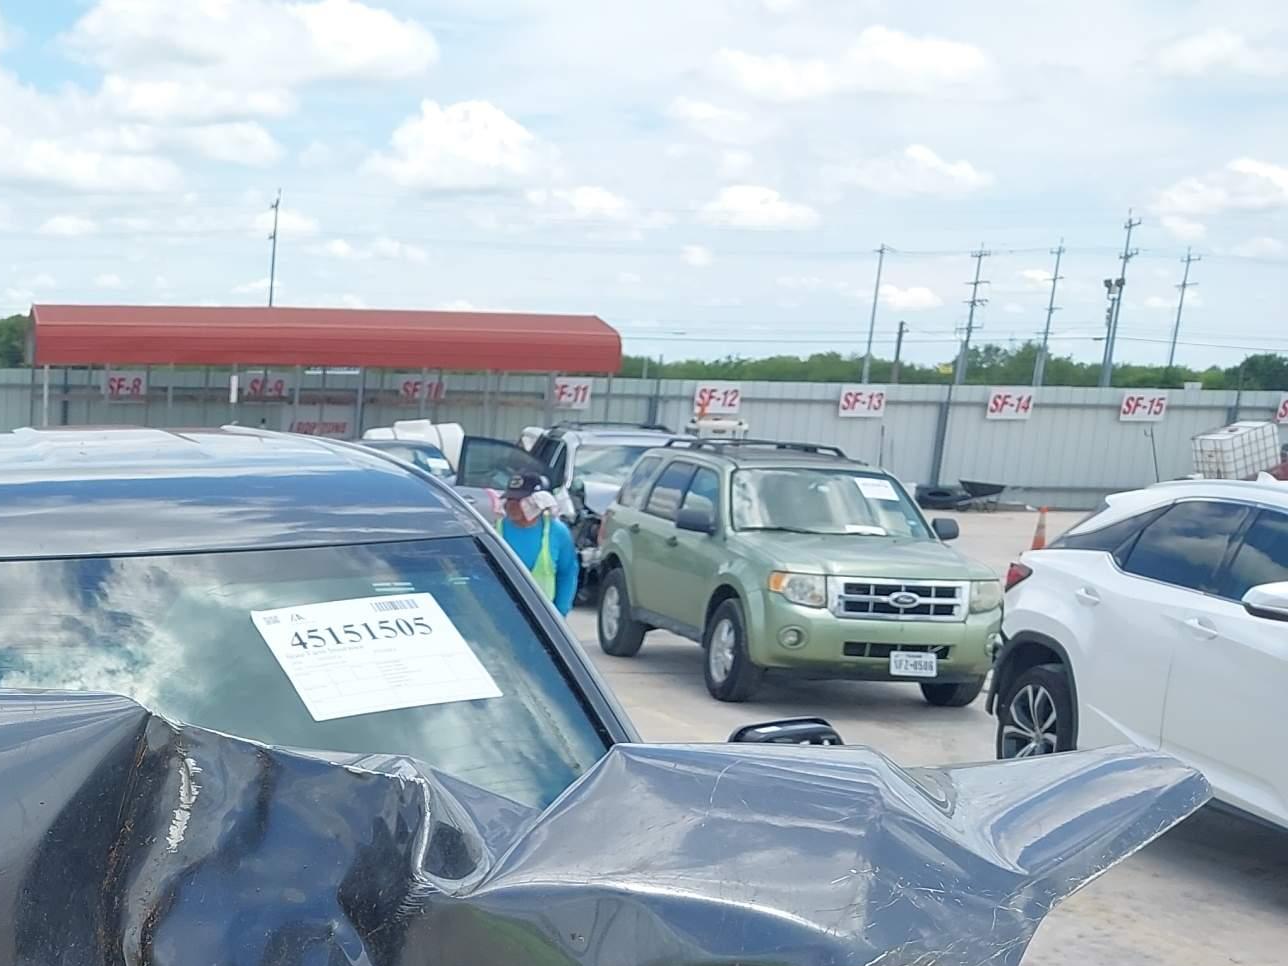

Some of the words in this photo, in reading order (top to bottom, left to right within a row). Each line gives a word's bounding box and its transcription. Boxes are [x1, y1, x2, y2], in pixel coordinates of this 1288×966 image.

[108, 377, 142, 397] SF-8
[697, 387, 739, 408] SF-12
[841, 391, 884, 411] SF-13
[989, 394, 1032, 414] SF-14
[1122, 396, 1166, 416] SF-15
[290, 616, 433, 650] 45151505
